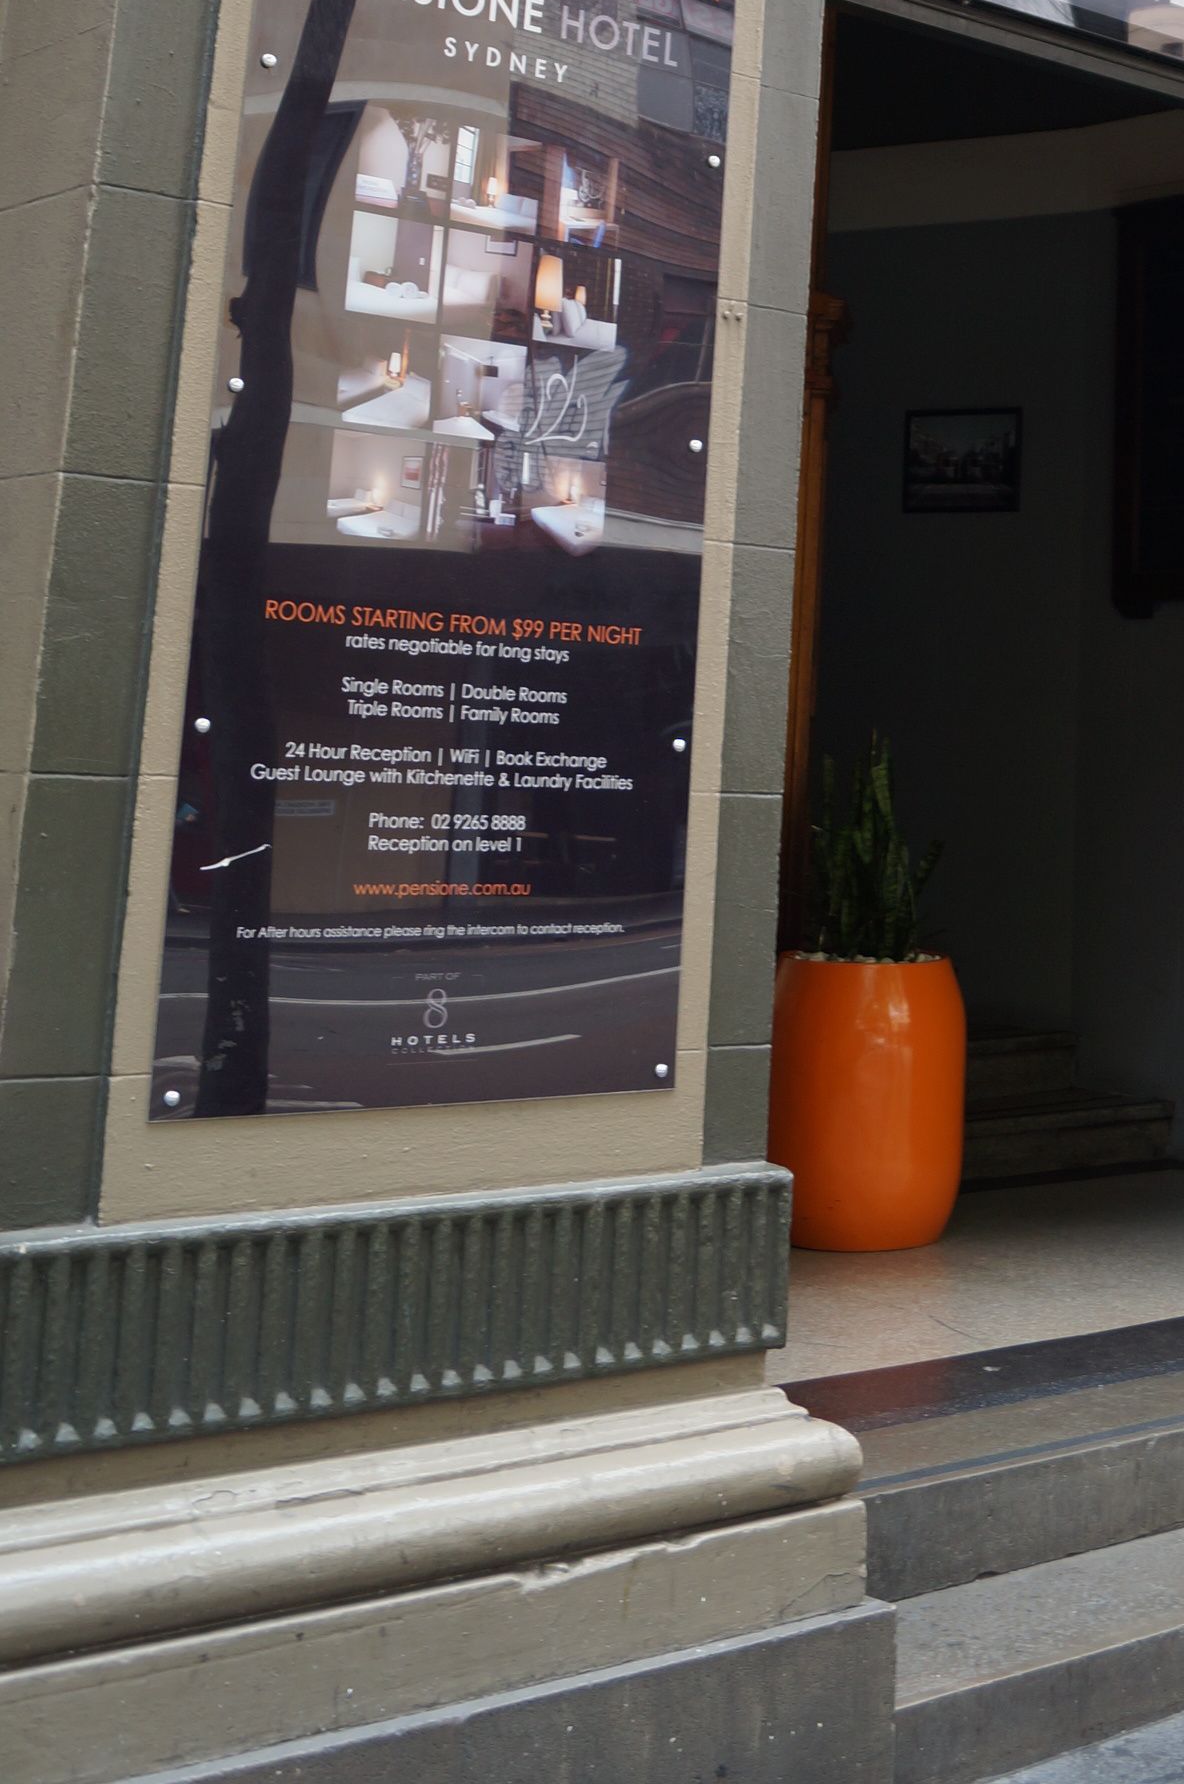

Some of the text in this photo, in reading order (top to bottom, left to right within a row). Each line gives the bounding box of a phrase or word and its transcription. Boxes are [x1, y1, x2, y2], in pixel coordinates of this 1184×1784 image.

[560, 5, 679, 68] HOTEL
[443, 36, 569, 83] SYDNEY
[265, 599, 643, 646] ROOMS STARTING FROM $99 PER NIGHT
[345, 633, 570, 664] rates negotiable for long stays
[340, 675, 389, 697] Single
[391, 679, 445, 698] Rooms
[461, 683, 517, 701] Double
[518, 686, 568, 704] Rooms
[347, 699, 388, 719] Triple
[390, 701, 444, 720] Rooms
[460, 705, 509, 726] Family
[510, 707, 560, 725] Rooms
[284, 741, 306, 758] 24
[308, 742, 348, 760] Hour
[349, 744, 432, 765] Reception
[449, 747, 480, 764] WiFi
[495, 749, 534, 766] Book
[535, 751, 608, 772] Exchange
[250, 763, 635, 792] Guest Lounge with Kitchenette & Laundry Facilities
[367, 812, 527, 831] Phone: 02 9265 8888
[367, 835, 523, 854] Reception on level 1
[353, 880, 532, 899] www.pensione.com.au
[236, 926, 257, 939] For
[257, 925, 288, 939] After
[289, 927, 322, 938] hours
[322, 925, 382, 938] assistance
[383, 925, 422, 939] please
[423, 924, 446, 939] ring
[446, 923, 467, 936] the
[467, 923, 515, 936] intercom
[516, 923, 528, 935] to
[529, 923, 573, 935] contact
[414, 972, 463, 981] PART OF
[422, 987, 448, 1029] 8
[390, 1033, 476, 1046] HOTELS
